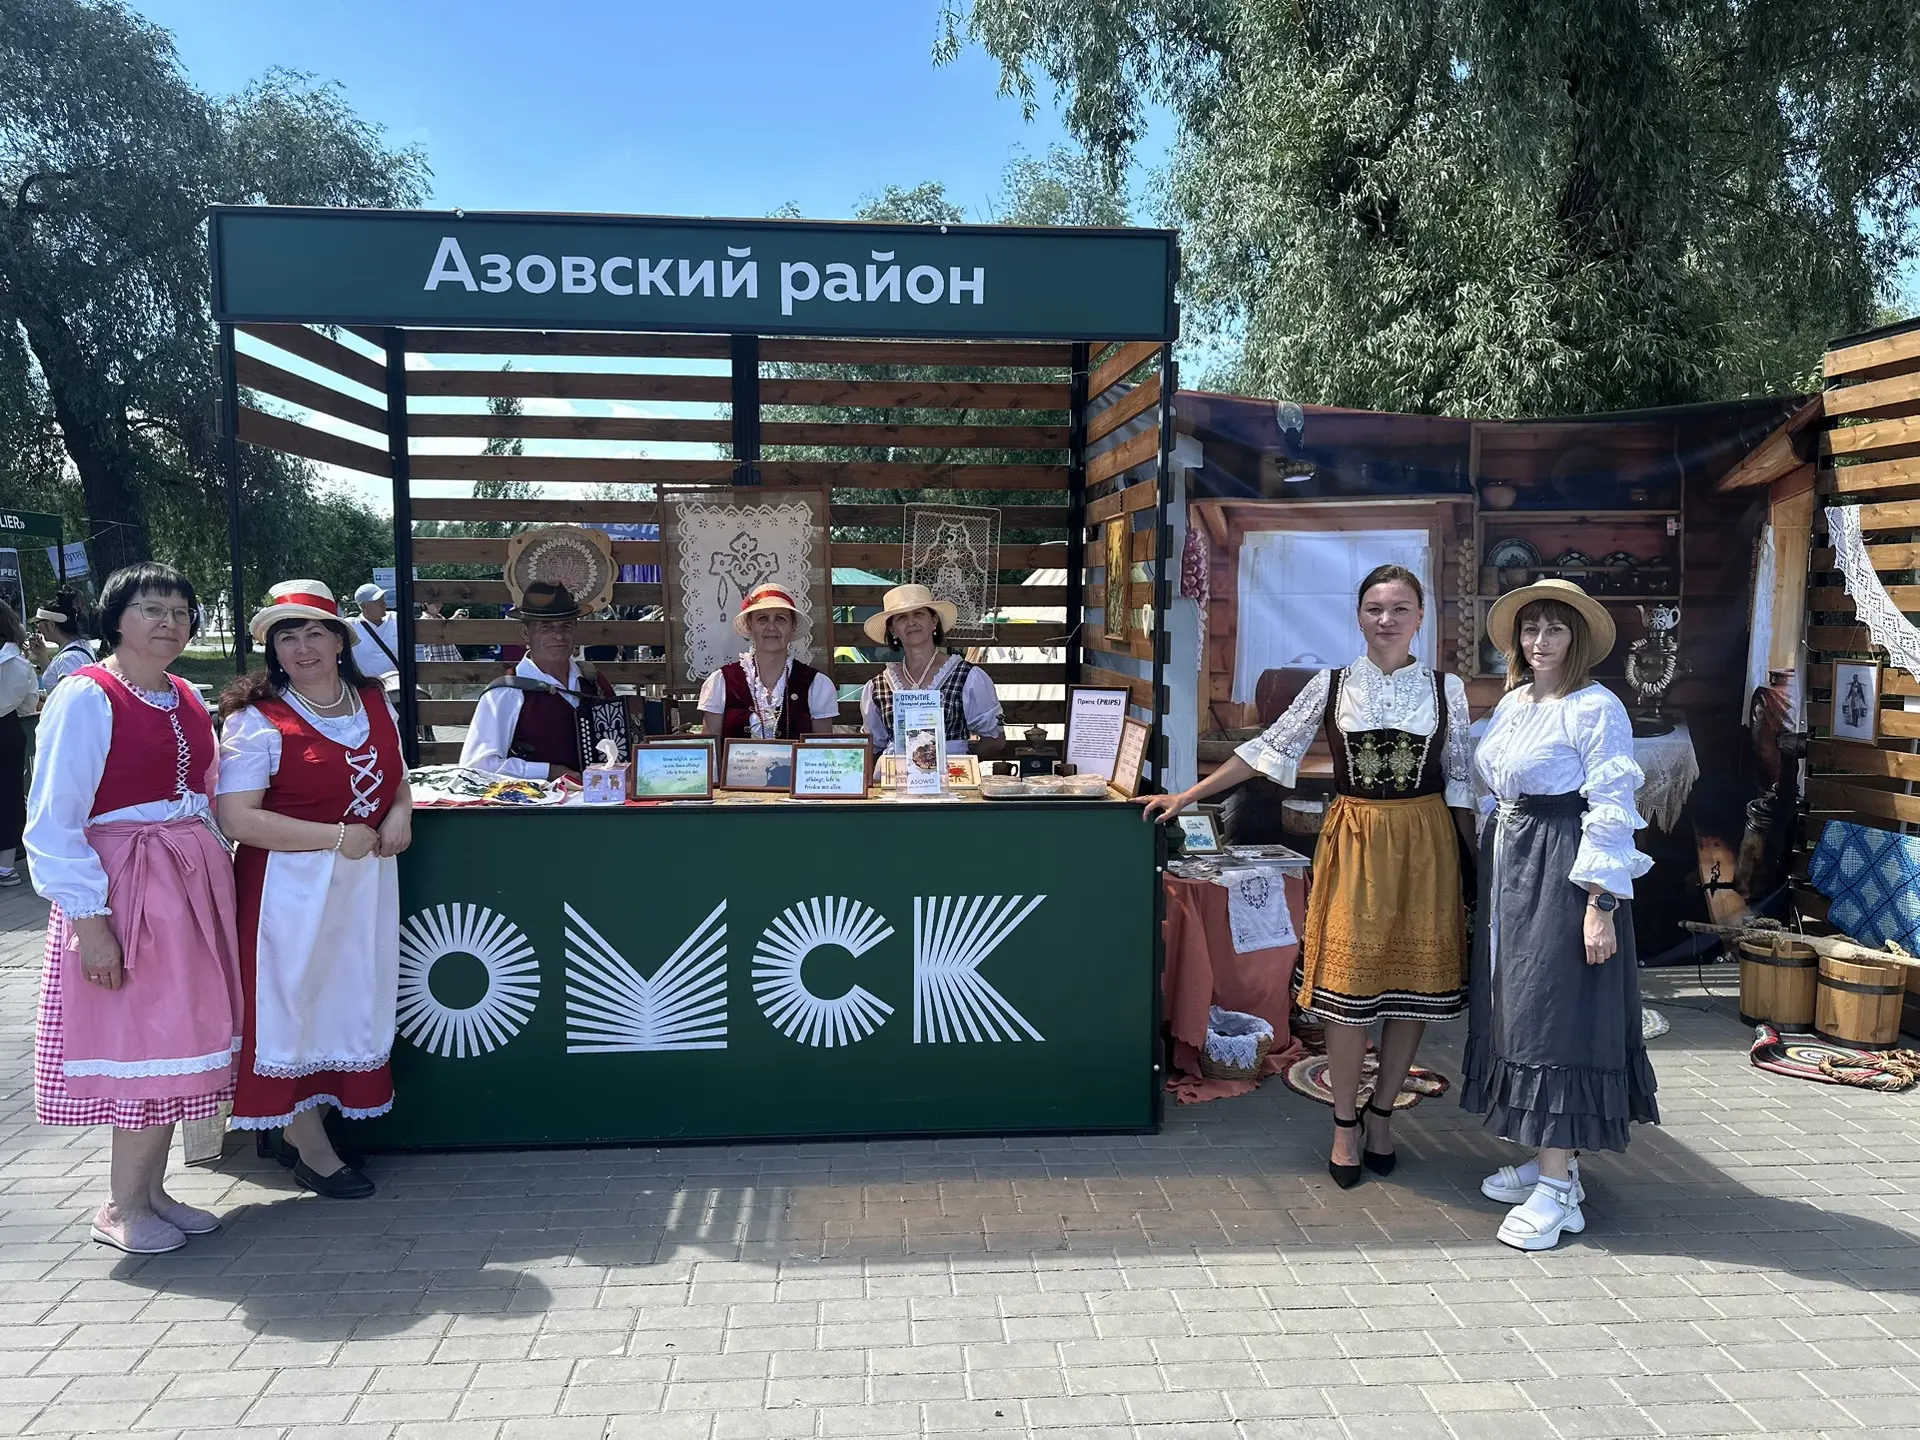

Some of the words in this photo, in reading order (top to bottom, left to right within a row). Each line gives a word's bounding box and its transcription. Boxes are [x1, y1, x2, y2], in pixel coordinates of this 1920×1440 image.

[424, 237, 758, 297] Азовский
[781, 250, 984, 316] район
[1096, 698, 1121, 706] (PRIPS)
[396, 895, 1047, 1058] ОМСК
